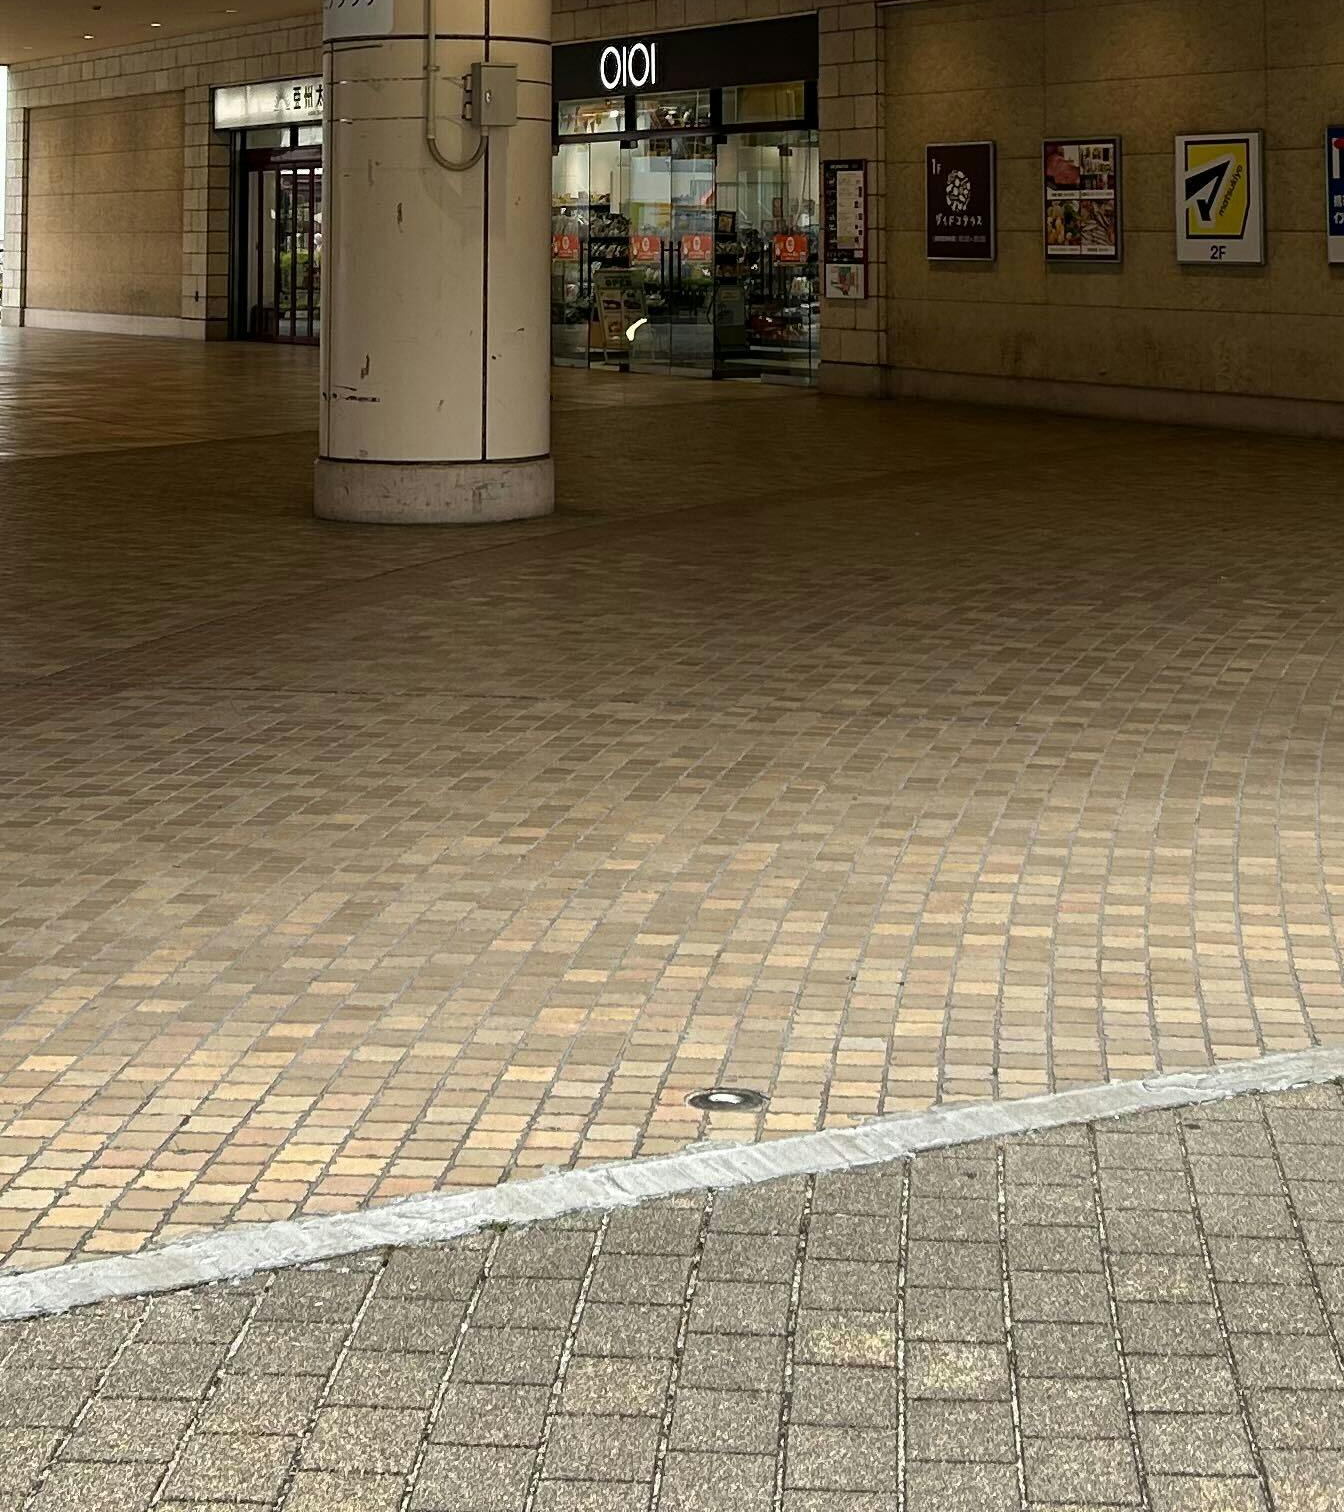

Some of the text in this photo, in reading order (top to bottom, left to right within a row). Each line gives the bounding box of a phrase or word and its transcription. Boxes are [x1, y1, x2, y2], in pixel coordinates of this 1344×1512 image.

[931, 158, 942, 175] 1F
[1219, 164, 1244, 217] matsukiyo
[1209, 245, 1227, 260] 2F
